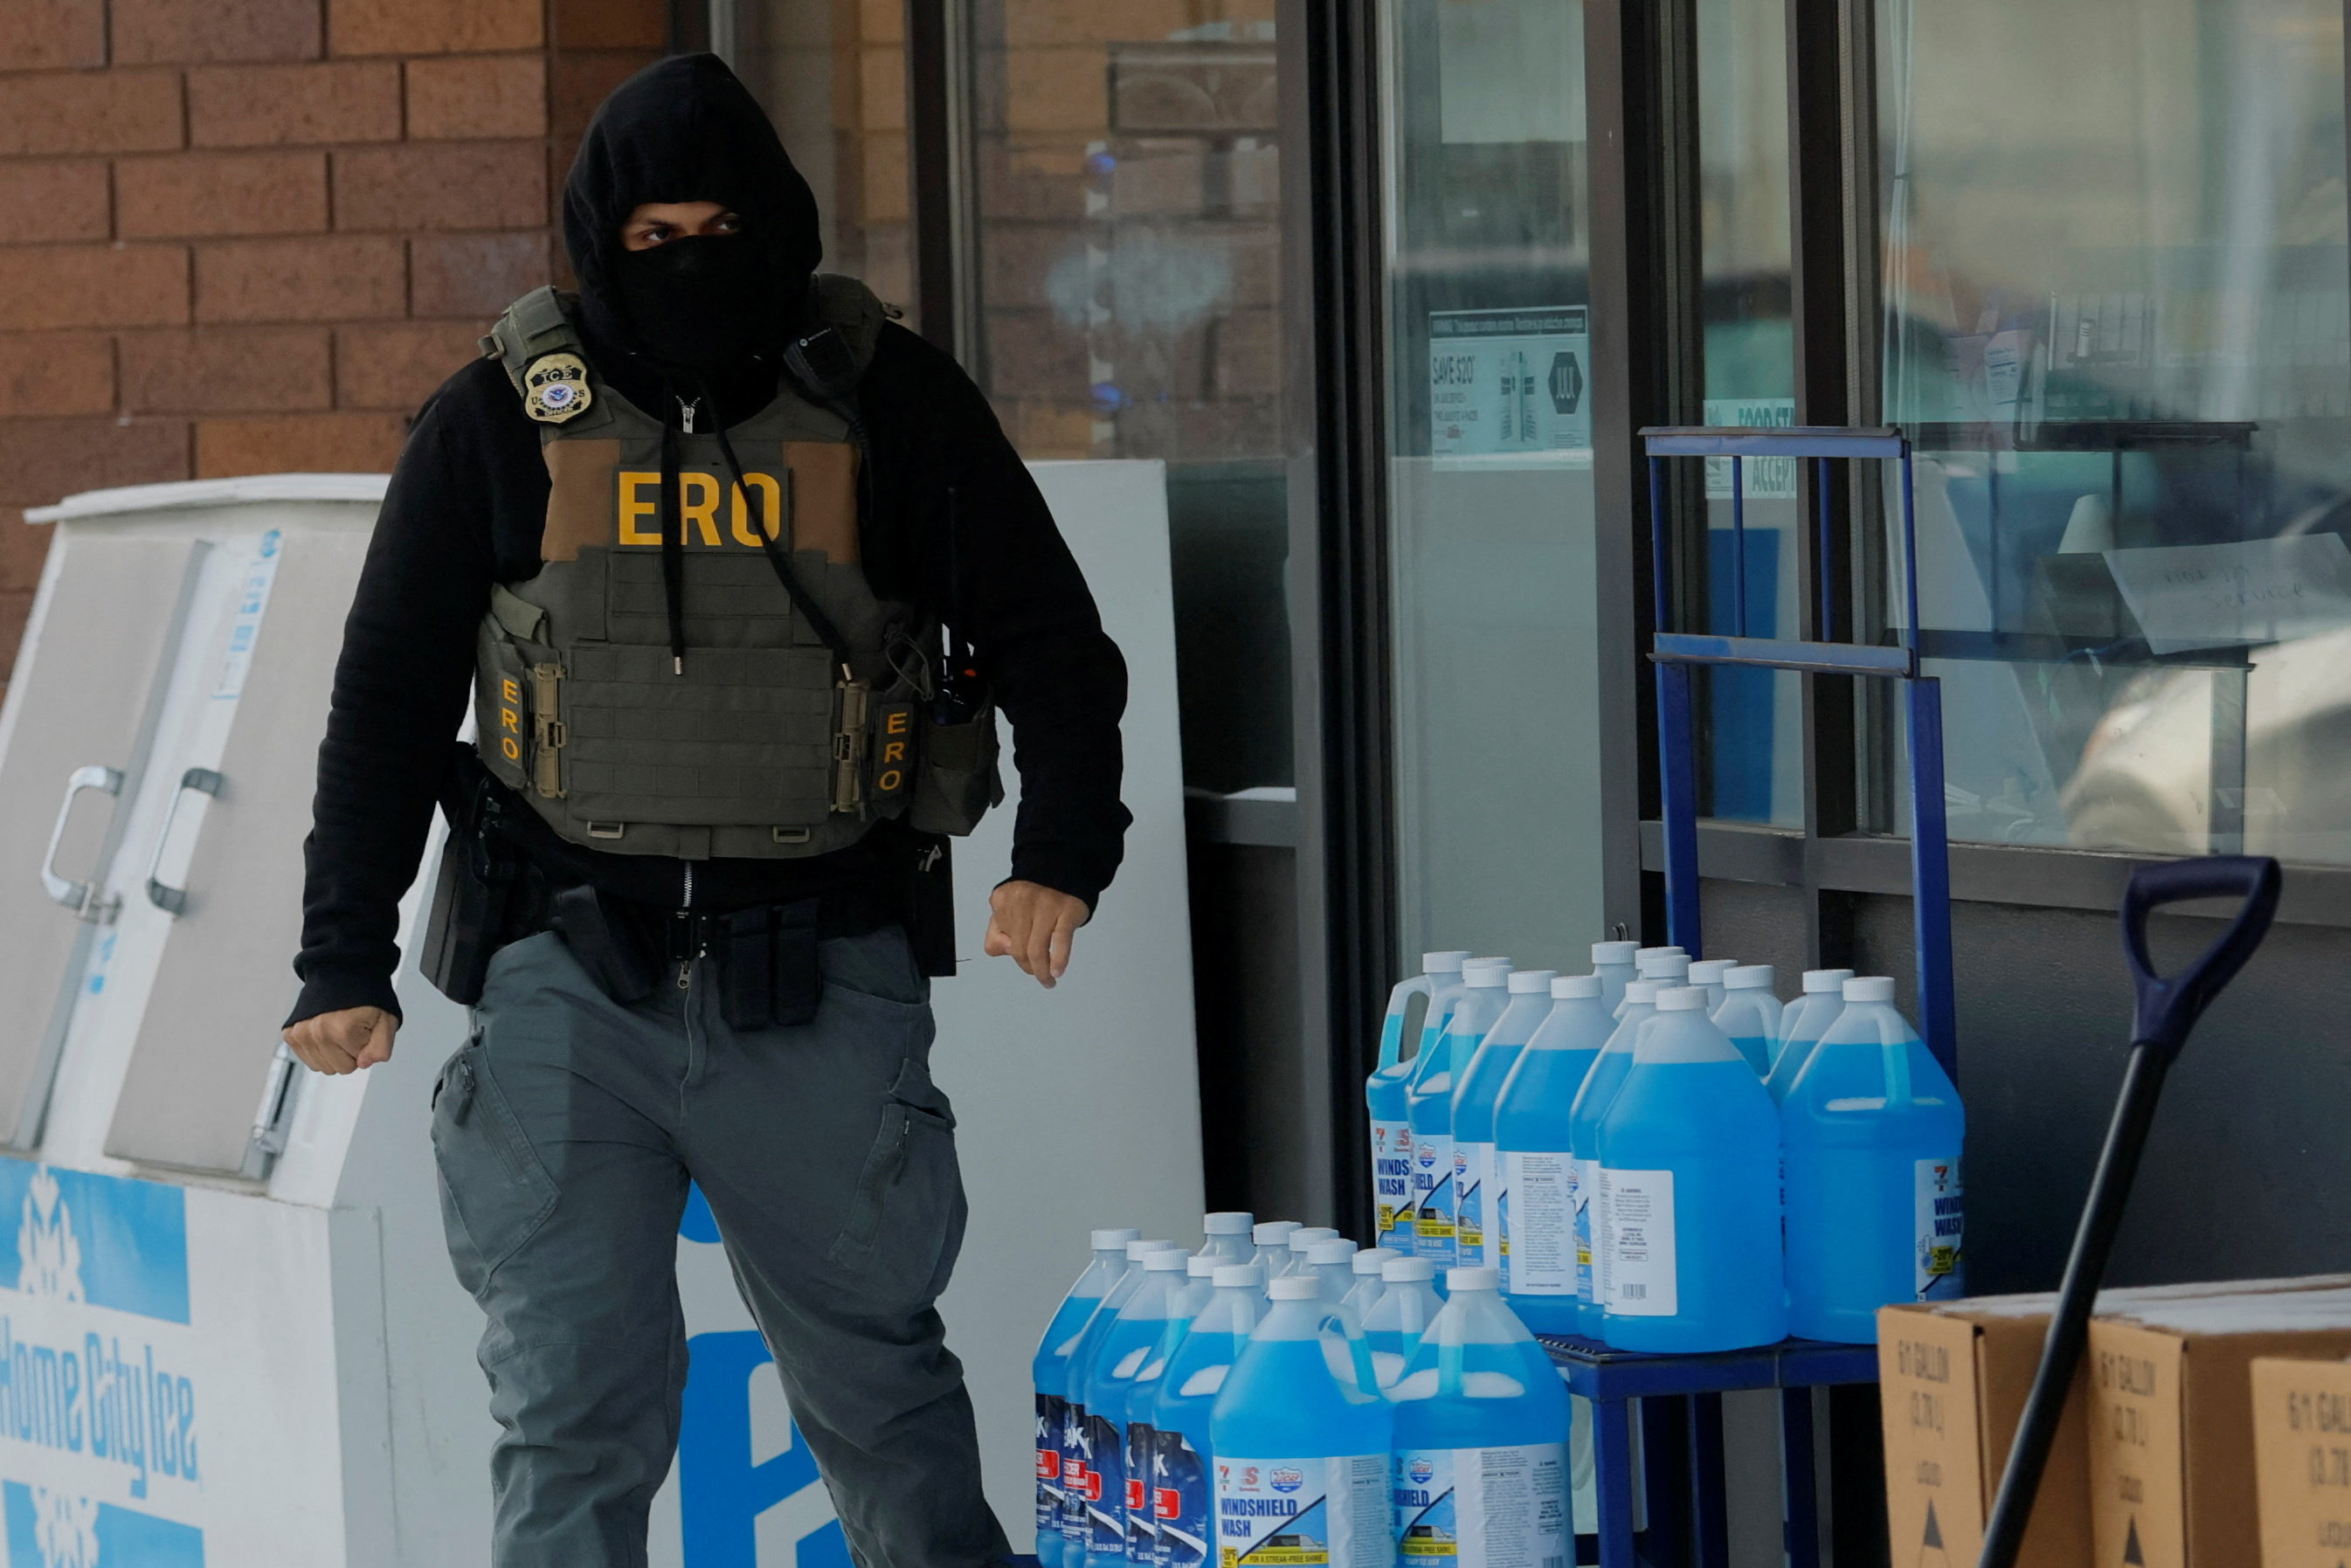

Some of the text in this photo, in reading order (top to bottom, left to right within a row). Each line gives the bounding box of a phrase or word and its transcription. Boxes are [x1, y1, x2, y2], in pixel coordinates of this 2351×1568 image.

[541, 370, 573, 383] ICE
[1433, 356, 1454, 385] SAVE
[531, 397, 538, 405] U
[619, 471, 780, 548] ERO
[501, 679, 520, 760] ERO
[879, 711, 909, 791] ERO
[1379, 1178, 1406, 1196] WASH
[1220, 1498, 1297, 1517] WINDSHIELD
[1221, 1519, 1251, 1538] WASH
